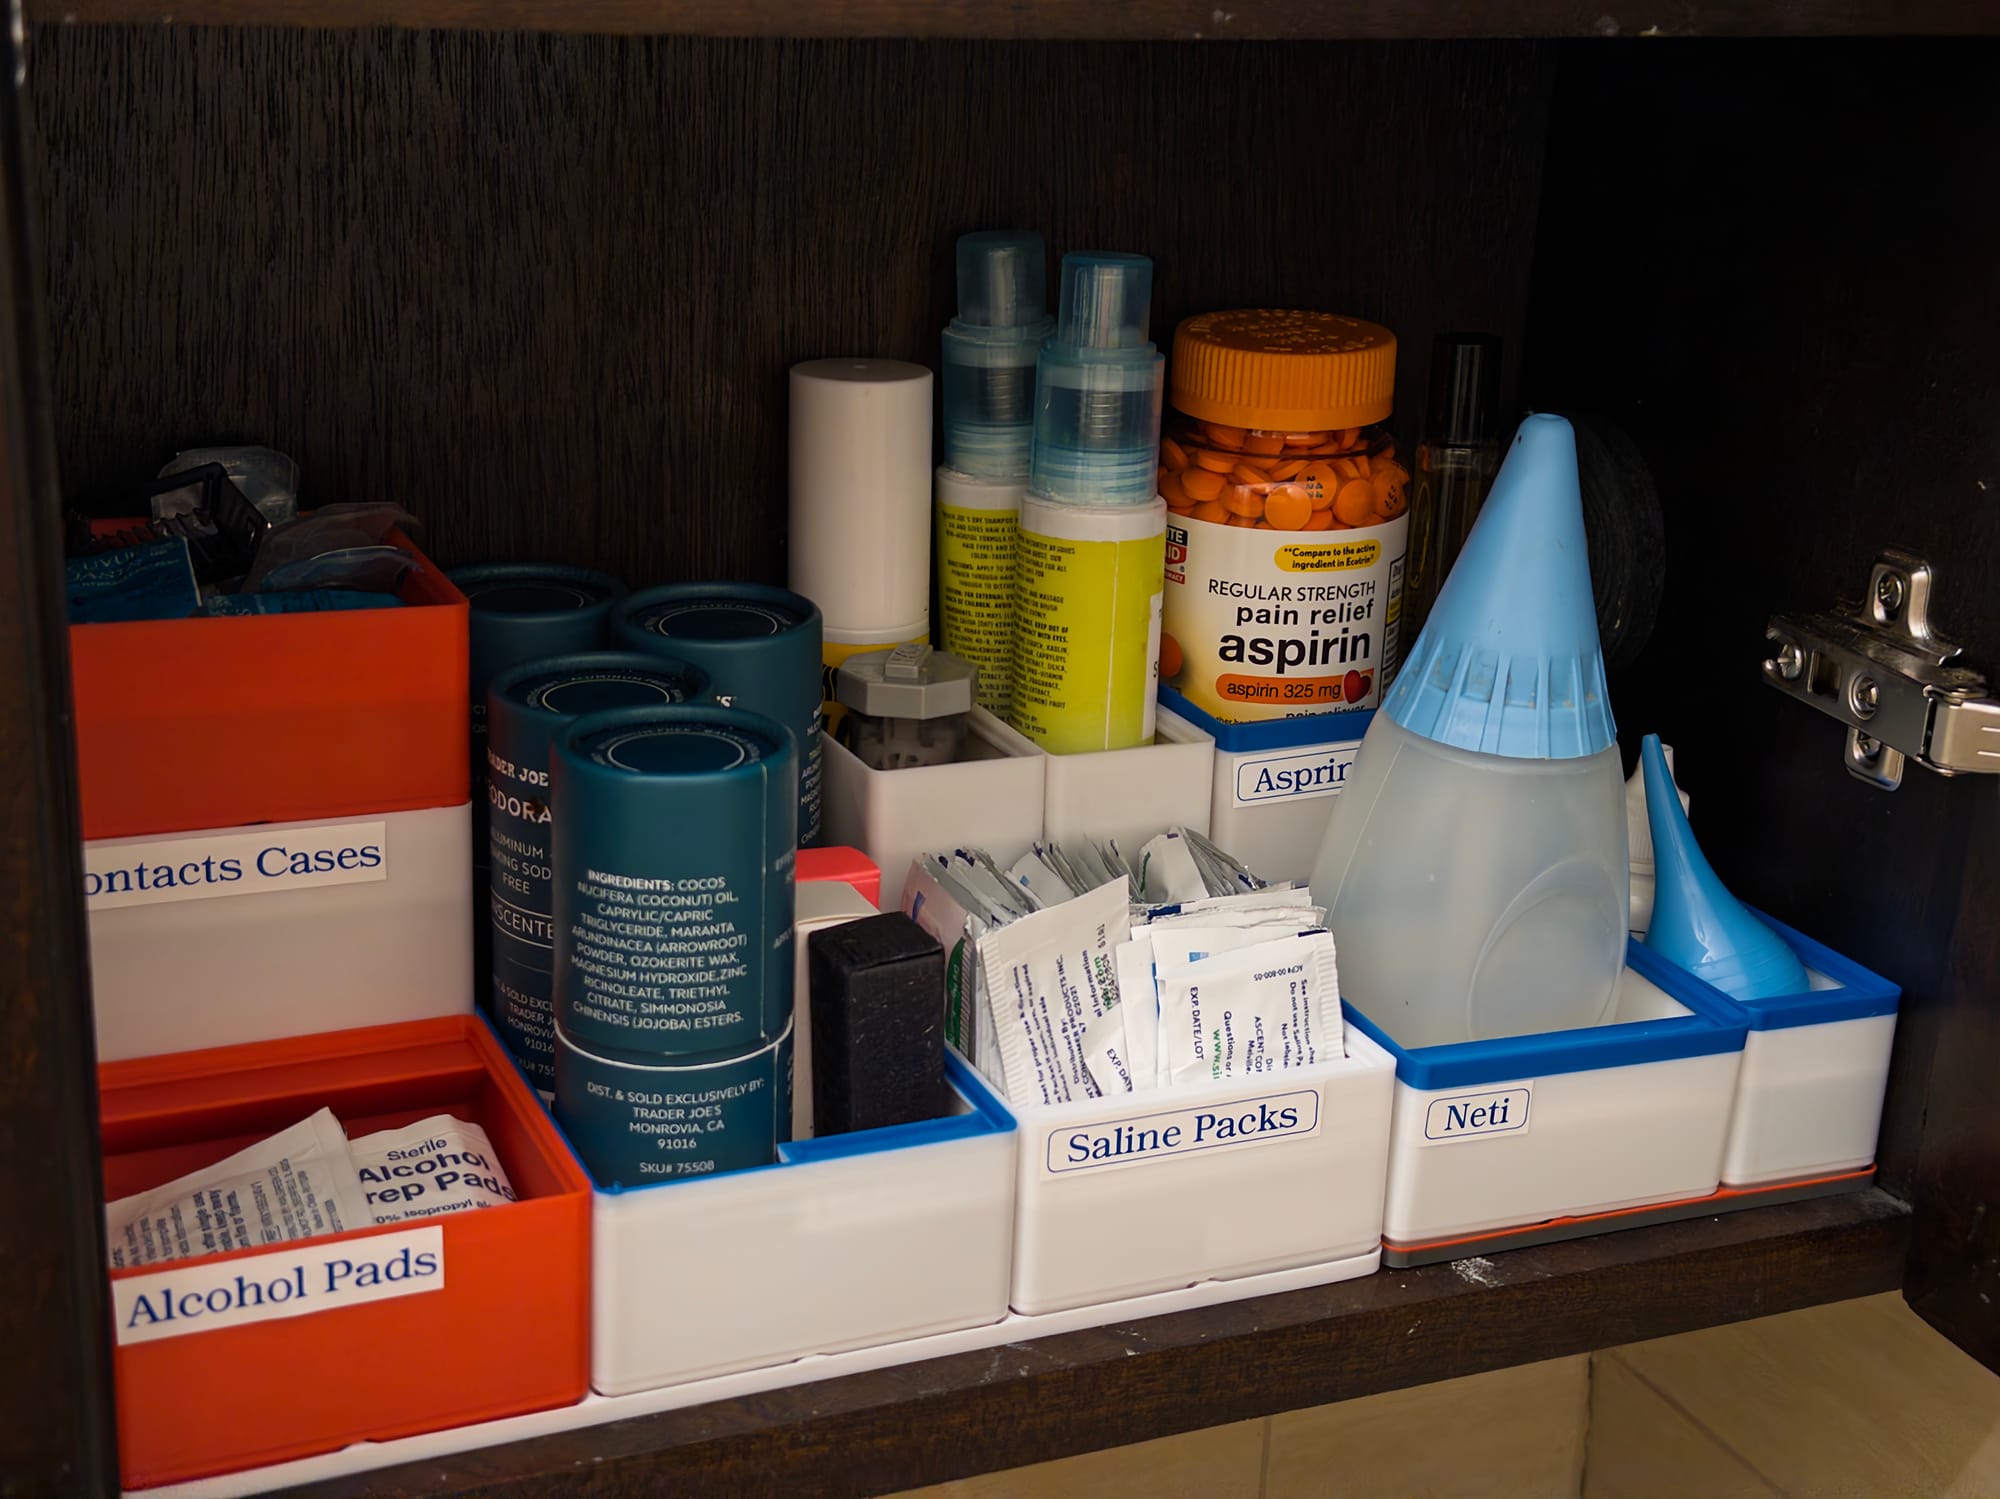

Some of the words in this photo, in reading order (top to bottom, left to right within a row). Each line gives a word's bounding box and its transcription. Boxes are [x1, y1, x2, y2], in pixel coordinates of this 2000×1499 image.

[1167, 529, 1183, 543] ITE
[1167, 545, 1181, 560] ID
[1343, 546, 1355, 555] the
[1356, 545, 1376, 554] active
[1292, 559, 1336, 571] ingredient
[1337, 559, 1345, 567] in
[1208, 579, 1291, 601] REGULAR
[1297, 580, 1376, 601] STRENGTH
[1236, 604, 1298, 626] pain
[1310, 599, 1374, 625] relief
[1218, 628, 1370, 674] aspirin
[1227, 683, 1279, 698] aspirin
[1283, 684, 1313, 698] 325
[1318, 684, 1341, 698] mg
[519, 767, 549, 787] JOE
[489, 784, 552, 823] ODORA
[491, 826, 544, 859] UMINUM
[84, 855, 242, 896] ontacts
[256, 844, 381, 877] Cases
[522, 861, 552, 880] SOD
[588, 869, 675, 891] INGREDIENTS:
[677, 877, 726, 891] COCOS
[502, 872, 530, 895] FREE
[577, 881, 634, 904] NUCIFERA
[637, 891, 713, 906] (COCONUT)
[494, 903, 552, 939] SCENTE
[597, 903, 713, 924] CAPRYLIC/CAPRIC
[581, 912, 667, 940] TRIGLYCERIDE,
[671, 922, 735, 938] MARANTA
[572, 925, 653, 952] ARUNDINACEA
[656, 934, 747, 954] (ARROWROOT)
[577, 943, 627, 966] POWDER,
[631, 955, 705, 969] OZOKERITE
[1056, 954, 1064, 975] INC.
[571, 955, 637, 982] MAGNESIUM
[1082, 950, 1100, 1008] Information
[584, 976, 665, 1001] RICINOLEATE,
[669, 984, 730, 999] TRIETHYL
[1190, 986, 1199, 1008] EXP.
[1290, 982, 1296, 995] Do
[509, 1002, 544, 1024] TRADER
[587, 992, 638, 1014] CITRATE,
[640, 1000, 726, 1015] SIMMONOSIA
[1060, 976, 1077, 1029] PRODUCTS
[573, 1001, 630, 1027] CHINENSIS
[633, 1016, 691, 1031] (JOJOBA)
[694, 1011, 744, 1029] ESTERS.
[525, 1037, 555, 1052] 91016
[1192, 1010, 1204, 1060] DATE/LOT
[1223, 1011, 1235, 1060] Questions
[1254, 1016, 1264, 1054] ASCENT
[1064, 1035, 1079, 1084] Distributed
[1106, 1048, 1121, 1070] EXP.
[1118, 1068, 1133, 1092] DAT
[1225, 1062, 1232, 1071] or
[587, 1081, 613, 1099] DIST.
[615, 1089, 625, 1100] &
[627, 1091, 663, 1105] SOLD
[666, 1085, 746, 1105] EXCLUSIVELY
[632, 1106, 685, 1120] TRADER
[1445, 1097, 1510, 1131] Neti
[629, 1122, 704, 1135] MONROVIA,
[706, 1119, 725, 1132] CA
[1067, 1126, 1181, 1163] Saline
[1194, 1103, 1298, 1142] Packs
[386, 1138, 448, 1162] Sterile
[657, 1138, 697, 1150] 91016
[358, 1153, 490, 1183] Alcohol
[639, 1162, 673, 1174] SKU#
[677, 1160, 715, 1174] 75508
[366, 1182, 425, 1205] rep
[434, 1170, 516, 1203] Pads
[376, 1215, 401, 1225] 0%
[127, 1267, 305, 1328] Alcohol
[325, 1247, 438, 1293] Pads
